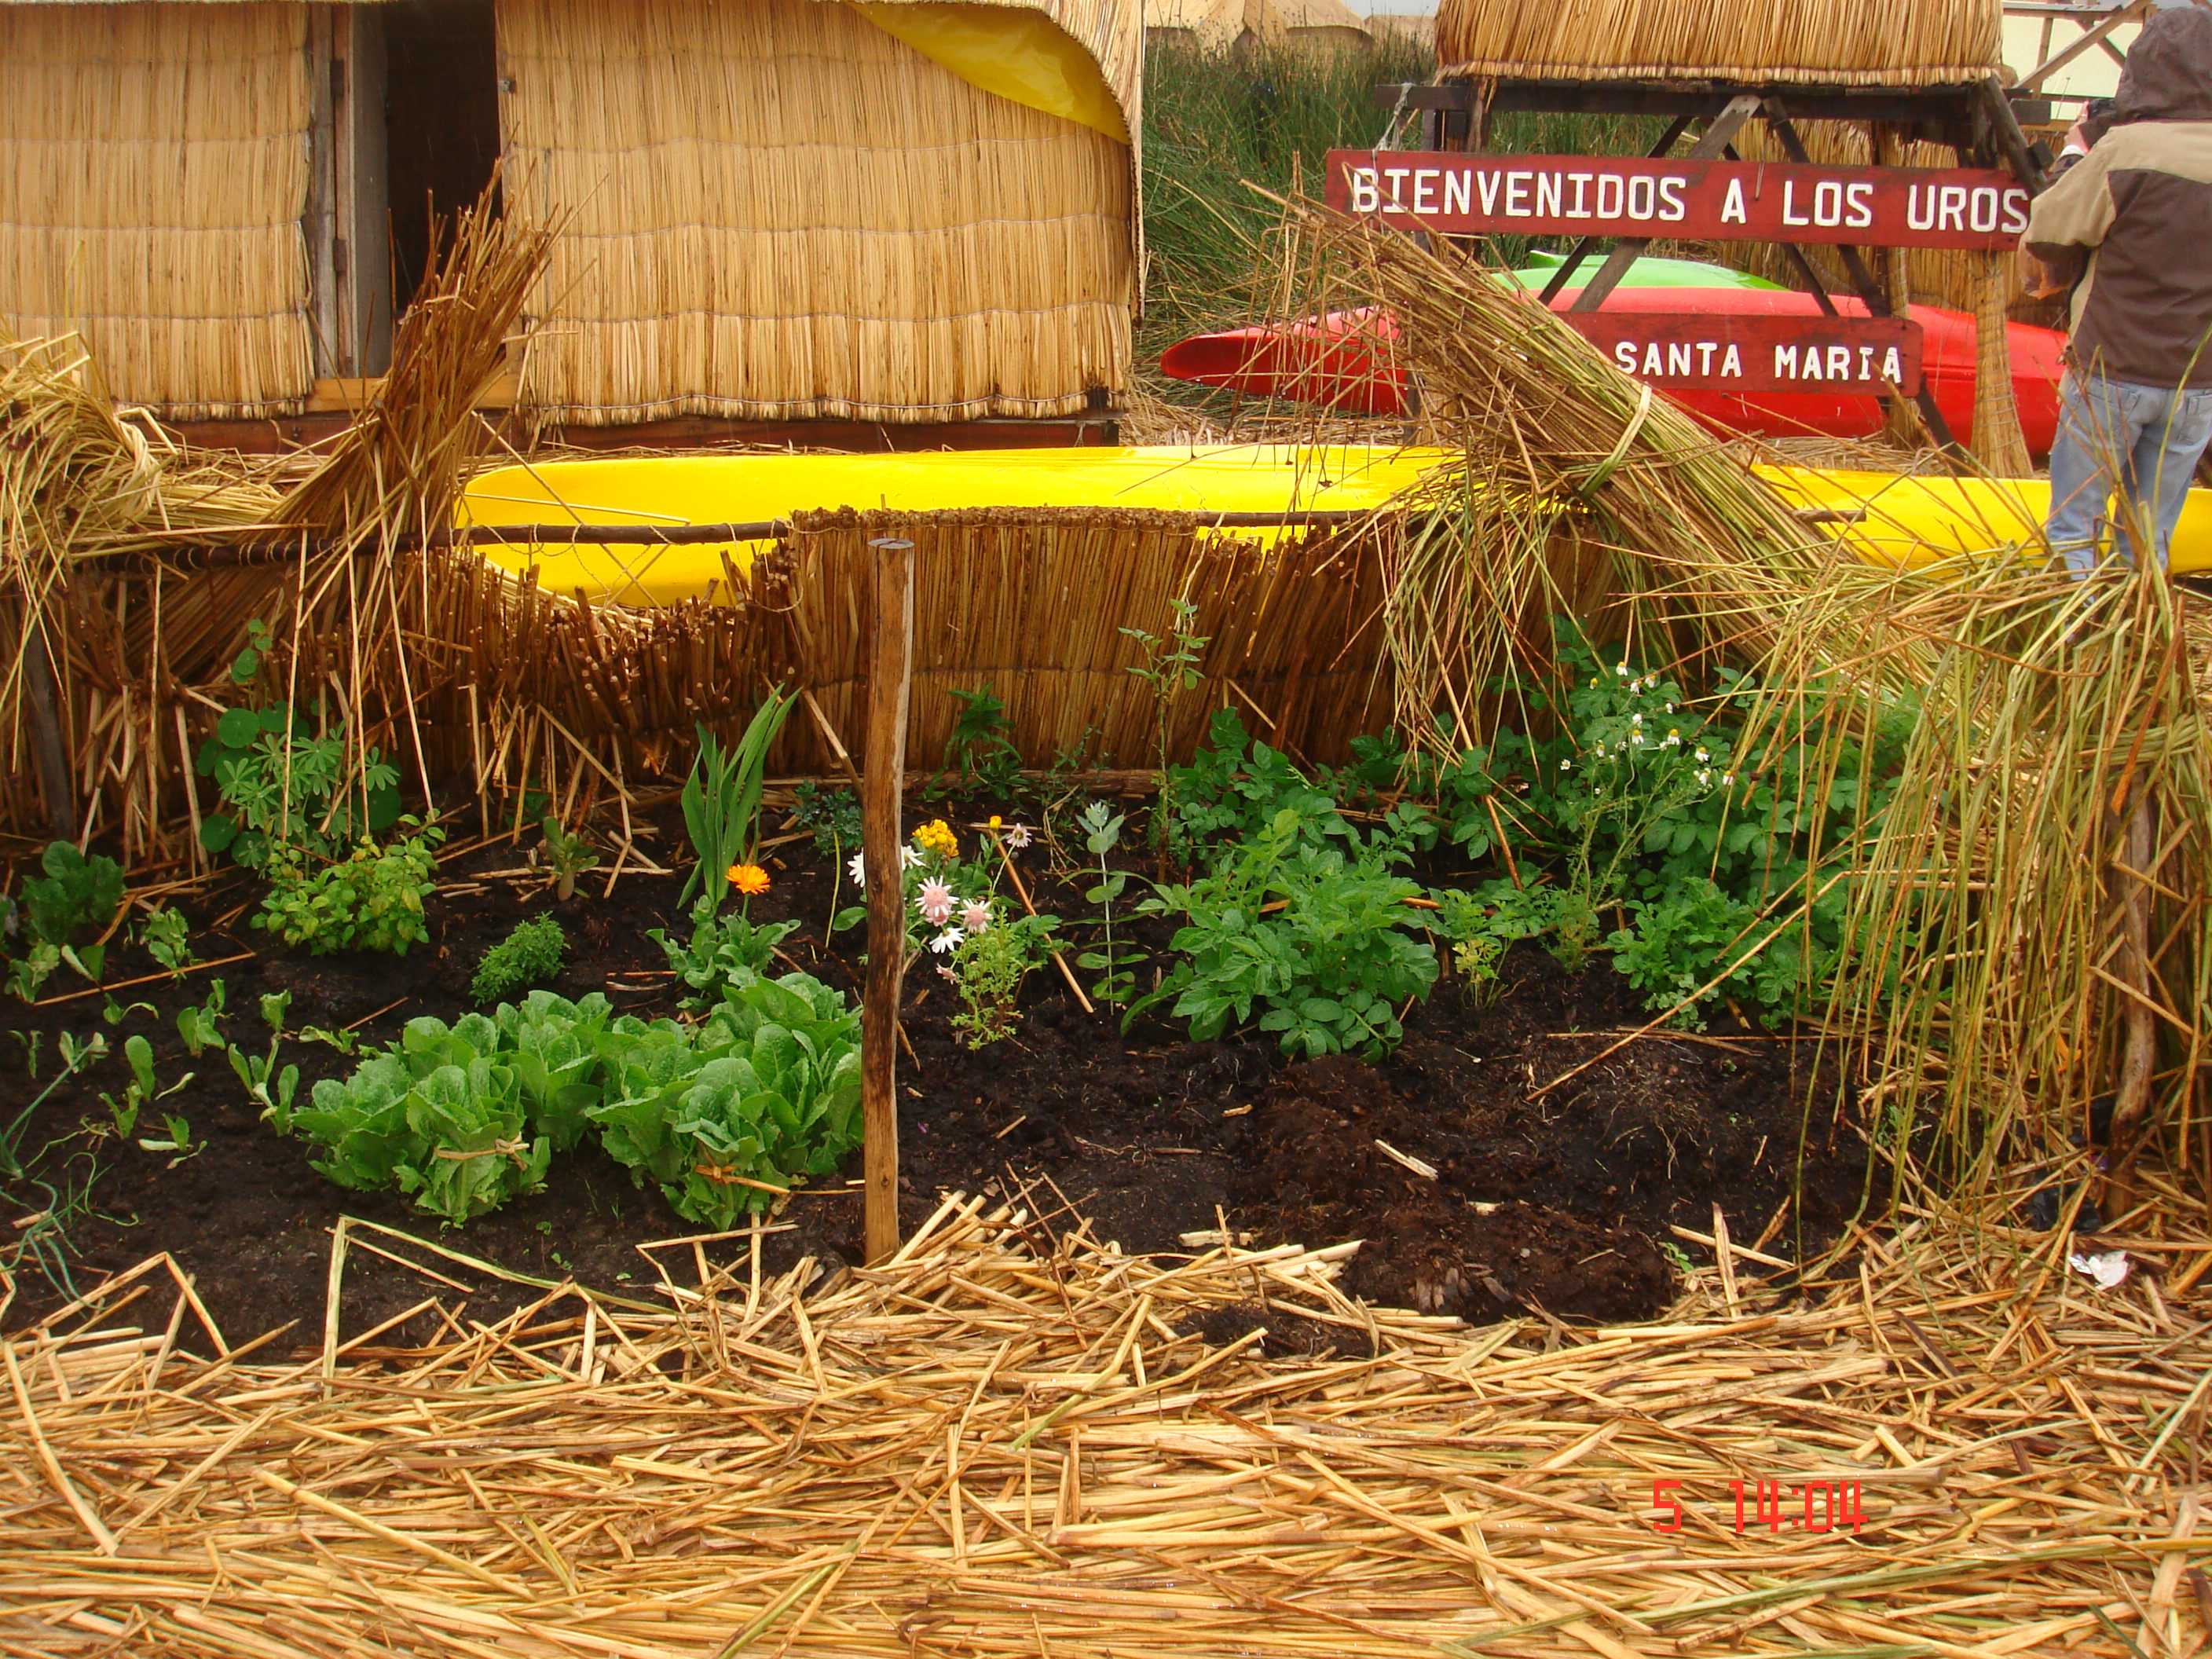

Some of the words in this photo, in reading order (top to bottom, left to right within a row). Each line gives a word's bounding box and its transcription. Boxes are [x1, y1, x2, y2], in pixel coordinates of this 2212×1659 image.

[1352, 168, 1686, 222] BIENVENIDOS
[1720, 178, 1747, 225] A
[1782, 181, 1873, 228] LOS
[1907, 184, 2028, 234] UROS
[1614, 341, 1742, 378] SANTA
[1774, 344, 1903, 384] MARIA
